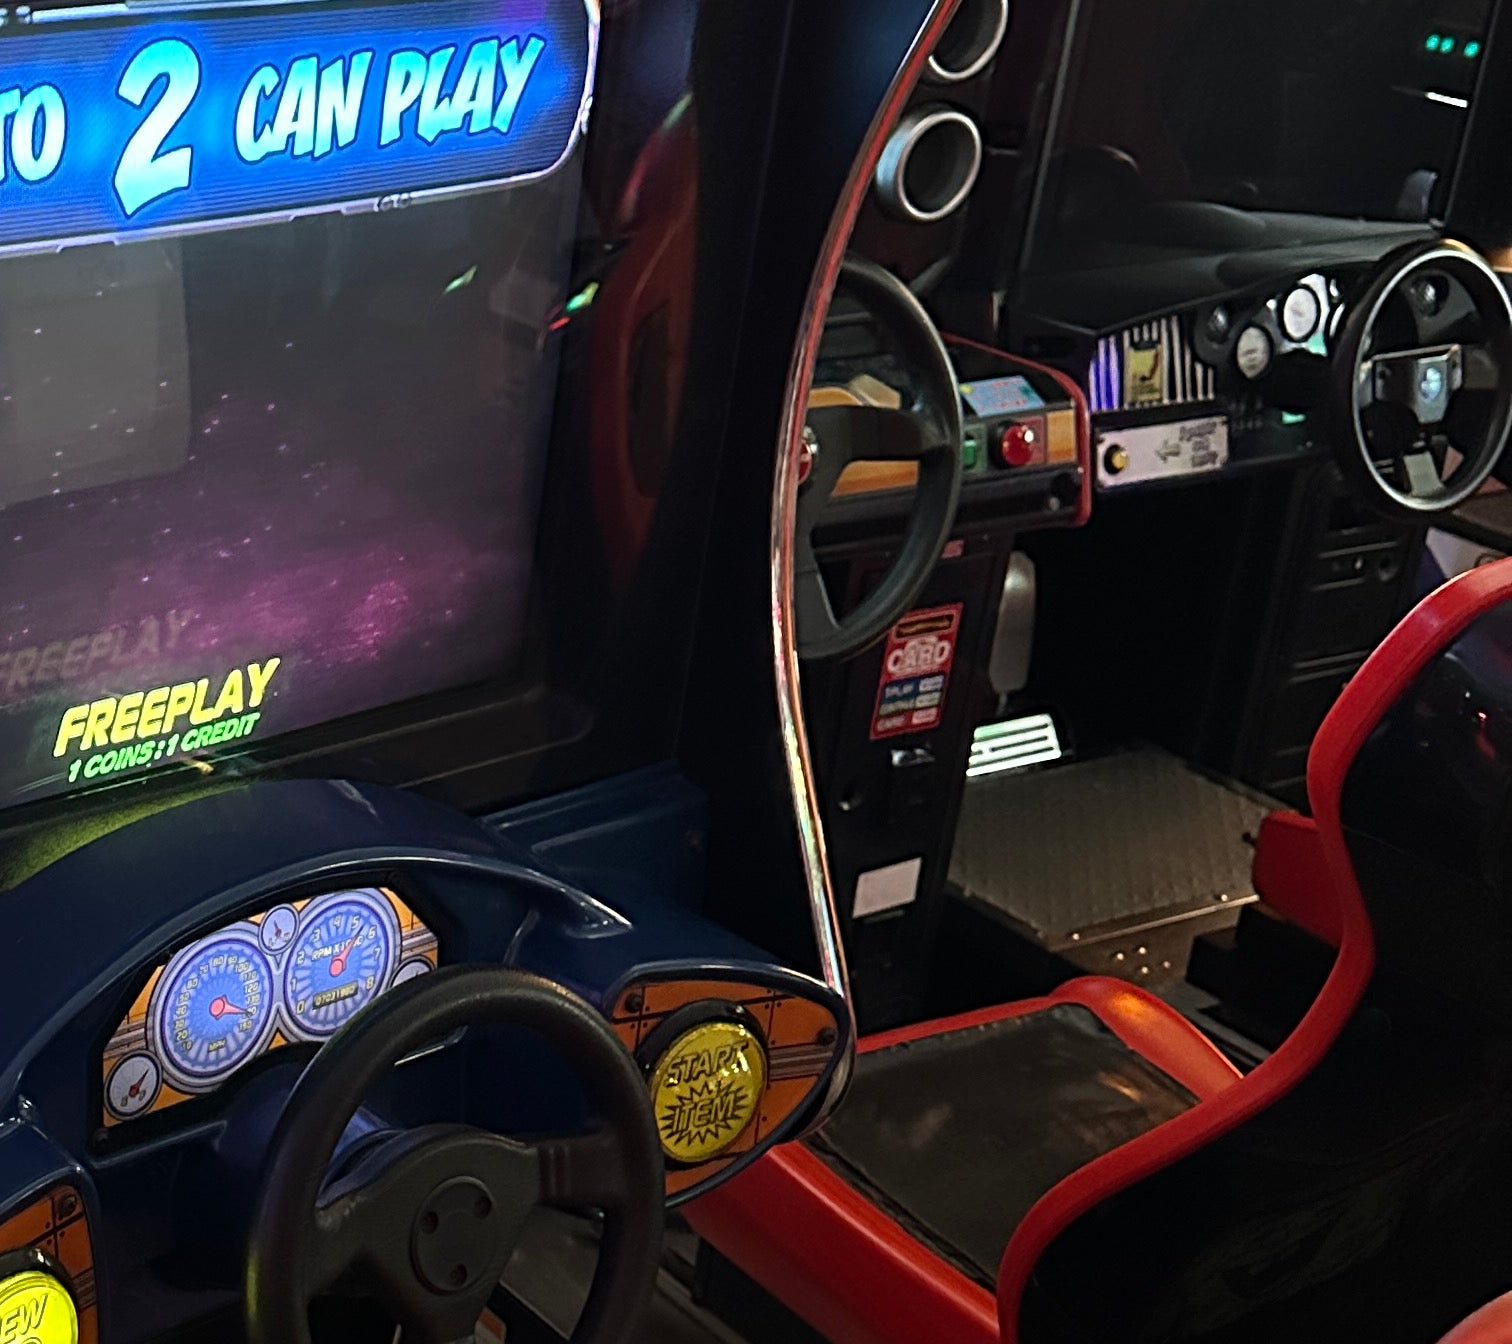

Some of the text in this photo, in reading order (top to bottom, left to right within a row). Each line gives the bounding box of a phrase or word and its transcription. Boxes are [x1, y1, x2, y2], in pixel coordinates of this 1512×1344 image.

[114, 39, 203, 217] 2
[236, 51, 373, 163] CAN
[379, 36, 545, 148] PLAY
[53, 657, 281, 758] FREEPLAY
[69, 760, 82, 783] 1
[181, 712, 261, 753] CREDIT
[311, 946, 333, 961] RPM
[666, 1040, 750, 1087] START
[670, 1091, 737, 1134] ITEM
